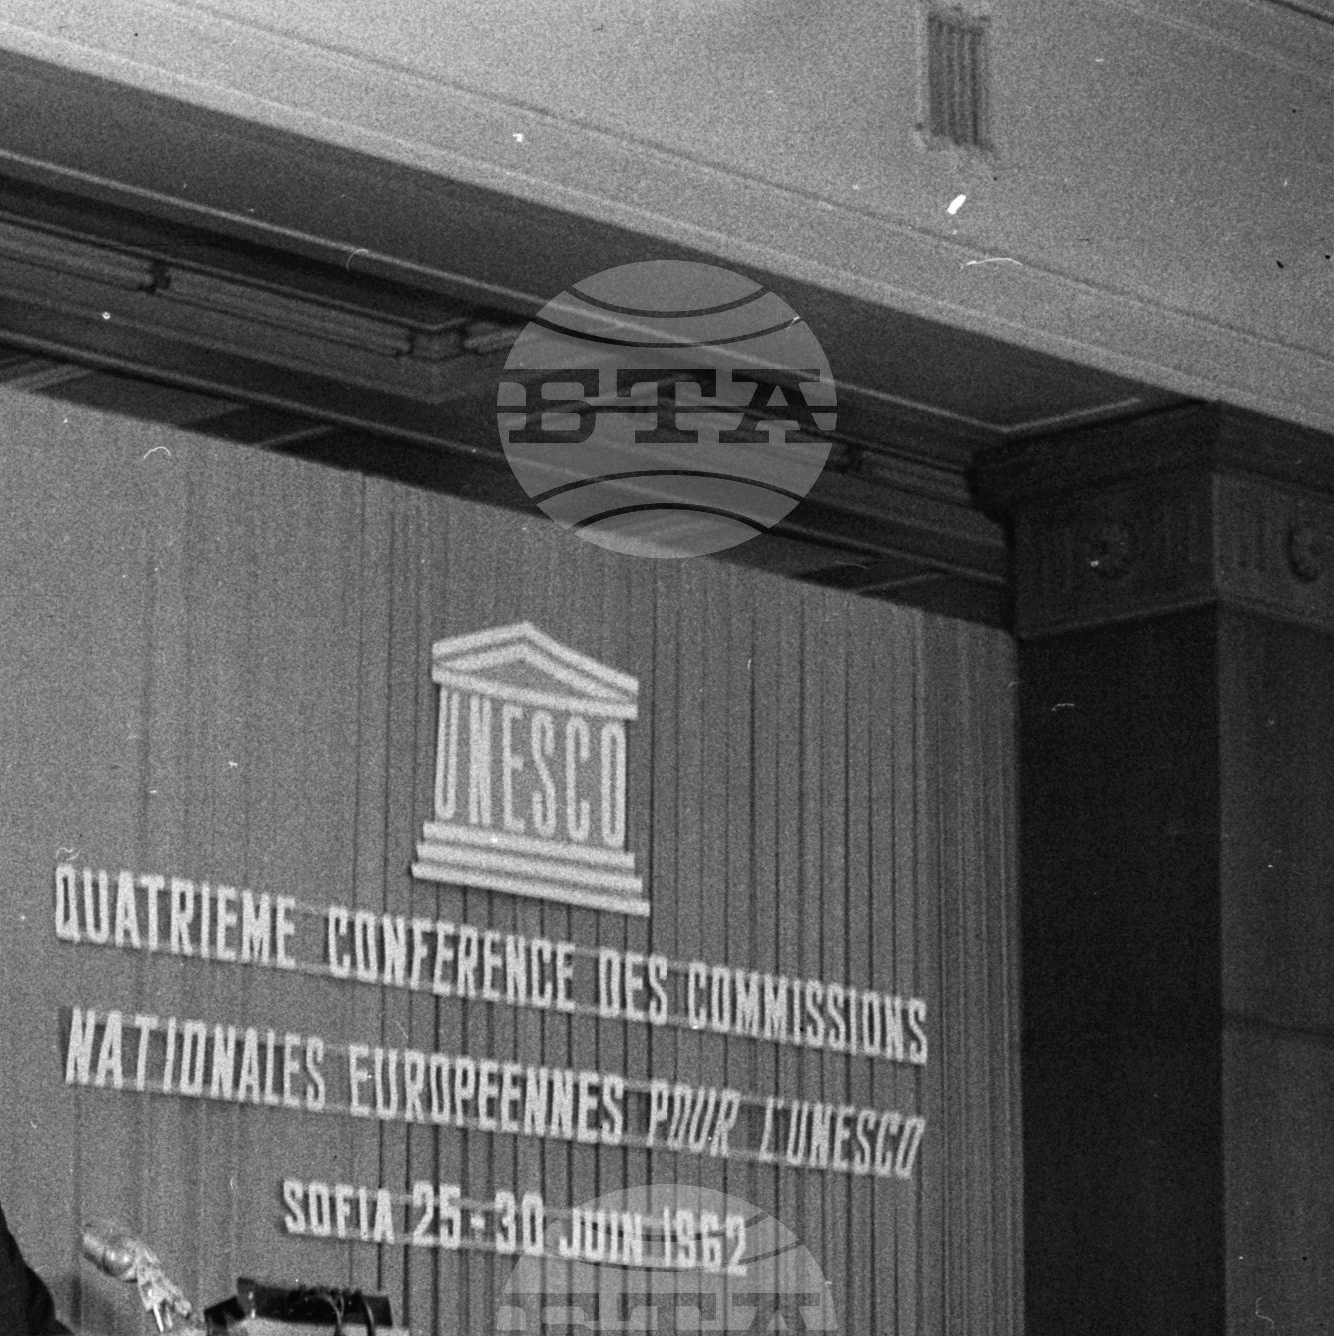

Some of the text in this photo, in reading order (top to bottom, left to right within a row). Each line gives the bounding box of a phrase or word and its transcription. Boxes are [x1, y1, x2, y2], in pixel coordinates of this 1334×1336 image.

[434, 686, 627, 849] UNESCO
[55, 864, 928, 1065] QUATRIEME CONFERENCE DES COMMISSIONS
[65, 1006, 926, 1179] NATIONALES EUROPEENNES POUR L'UNESCO
[283, 1179, 395, 1245] SOFIA
[558, 1206, 643, 1266] JUIN
[663, 1206, 749, 1277] 1962
